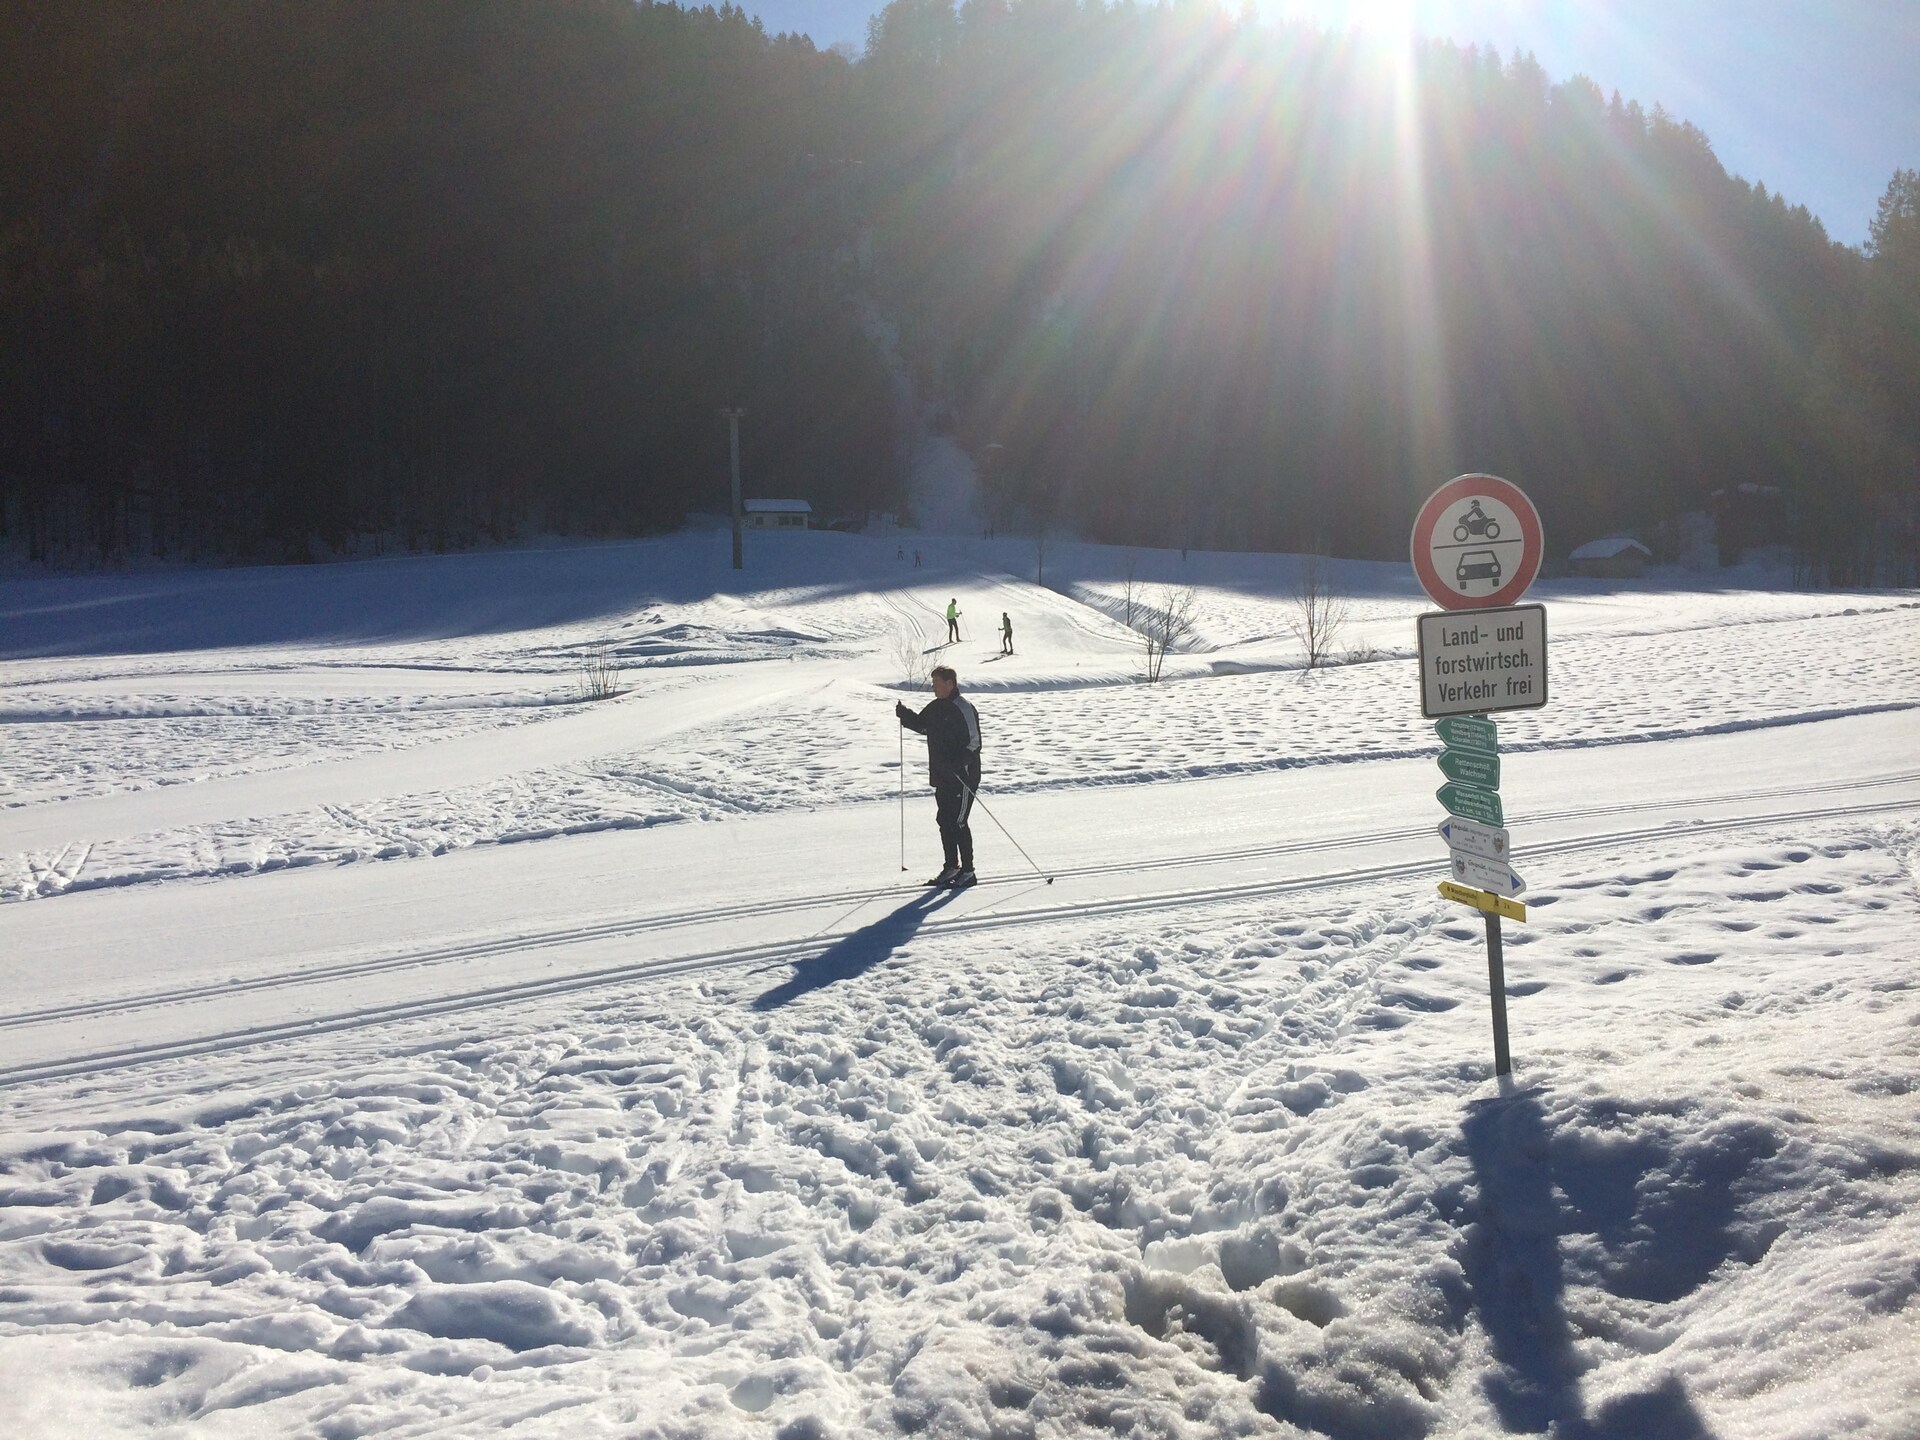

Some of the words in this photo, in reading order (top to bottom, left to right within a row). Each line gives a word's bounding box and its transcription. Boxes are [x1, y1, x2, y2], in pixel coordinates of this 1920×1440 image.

[1442, 625, 1488, 647] Land-
[1497, 620, 1524, 642] und
[1435, 648, 1533, 675] forstwirtsch.
[1438, 679, 1497, 702] Verkehr
[1506, 674, 1532, 695] frei
